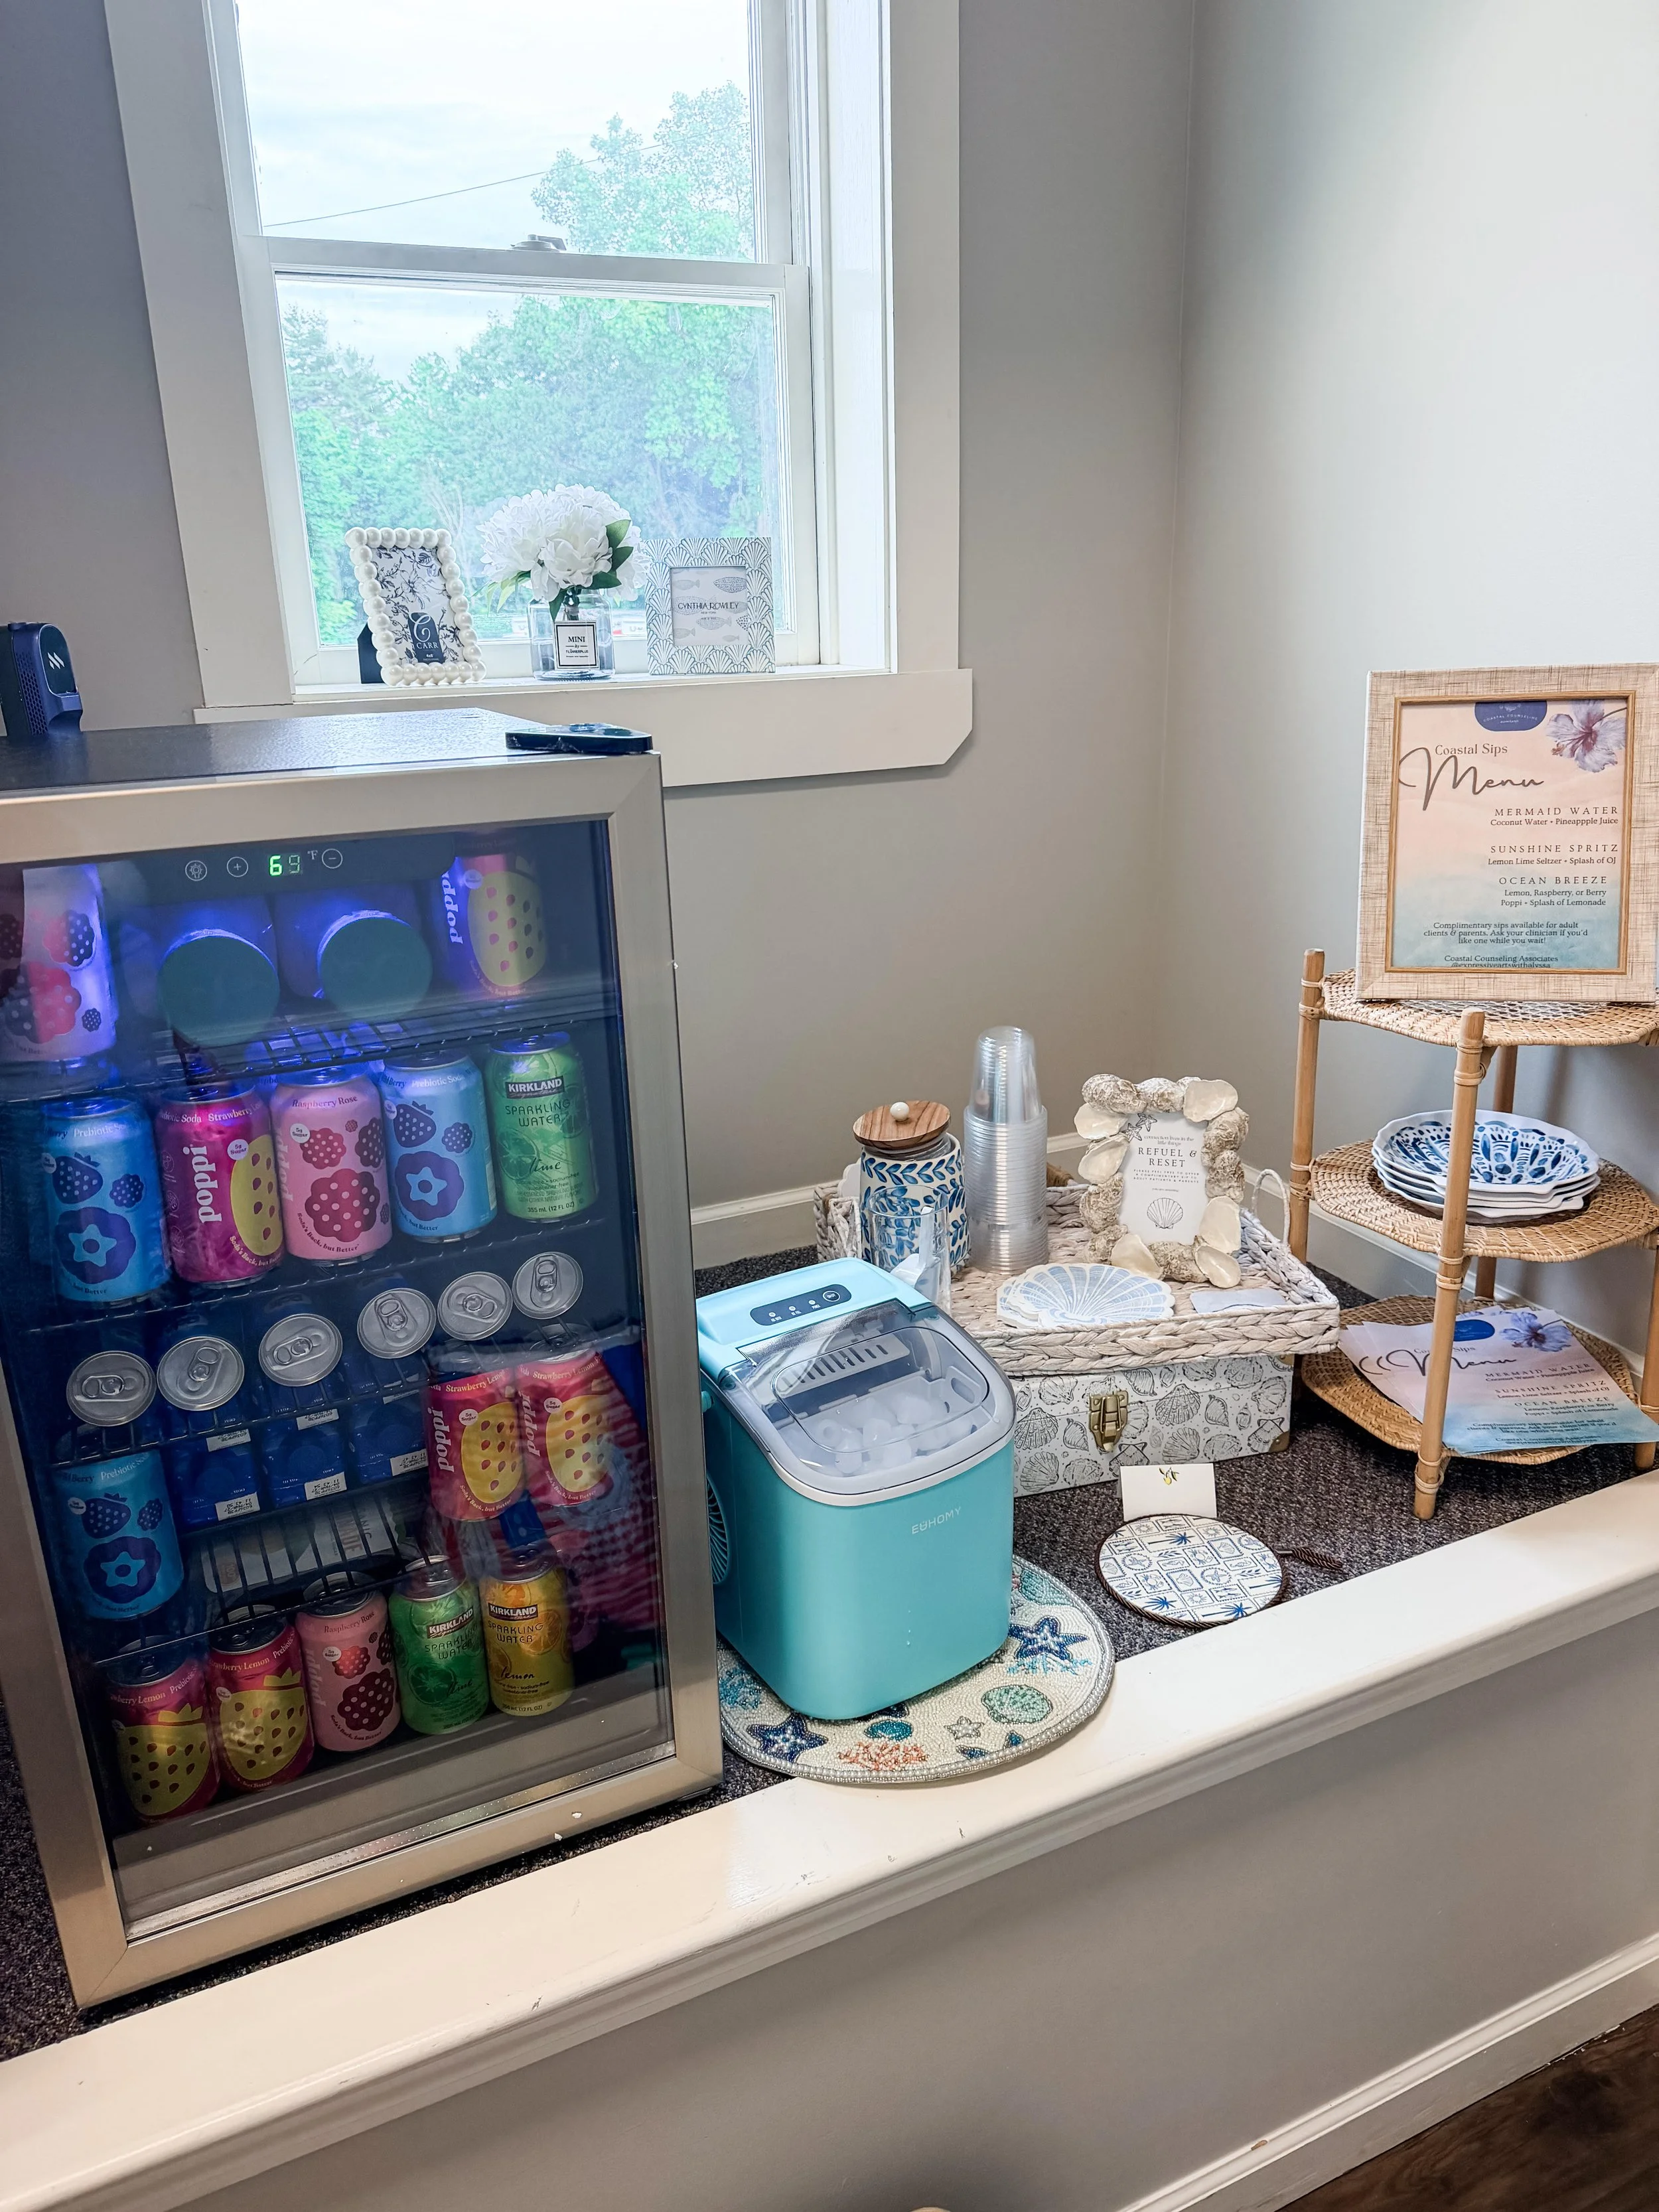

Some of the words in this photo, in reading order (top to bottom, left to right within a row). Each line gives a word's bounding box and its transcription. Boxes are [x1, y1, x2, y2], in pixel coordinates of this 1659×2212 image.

[1435, 744, 1477, 755] Coastal
[1482, 743, 1508, 757] Sips
[1398, 747, 1544, 811] Menu
[1494, 807, 1561, 816] MERMAID
[1570, 806, 1618, 815] WATER
[1555, 818, 1598, 826] Pineappple
[1490, 845, 1561, 853] SUNSHINE
[1569, 857, 1595, 865] Splash
[1567, 929, 1588, 938] you'd
[411, 1077, 447, 1088] Prebiotic
[508, 1078, 563, 1092] KIRKLAND
[292, 1099, 337, 1109] Raspberry
[338, 1095, 358, 1106] Rose
[505, 1099, 571, 1115] SPARKLING
[181, 1114, 202, 1123] Soda
[208, 1108, 252, 1122] Strawberry
[518, 1114, 561, 1127] WATER
[74, 1126, 113, 1138] Prebiotic
[1138, 1147, 1183, 1157] REFUEL
[1149, 1158, 1185, 1167] RESET
[182, 1143, 222, 1224] poppi
[323, 1243, 335, 1252] but
[336, 1244, 358, 1253] Better
[1548, 1363, 1591, 1372] WATER
[533, 1370, 572, 1380] Strawberry
[445, 1380, 487, 1392] Strawberry
[1563, 1380, 1607, 1389] SPRITZ
[518, 1391, 541, 1457] poppi
[427, 1406, 455, 1473] poppi
[100, 1462, 137, 1481] Prebiotic
[490, 1604, 537, 1616] KIRKLAND
[324, 1619, 361, 1634] Raspberry
[360, 1611, 375, 1622] Rose
[429, 1608, 474, 1634] KIRKLAND
[488, 1620, 543, 1635] SPARKLING
[425, 1623, 478, 1653] SPARKLING
[497, 1635, 533, 1644] WATER
[439, 1639, 473, 1660] WATER
[244, 1657, 270, 1670] Lemon
[500, 1666, 535, 1679] lemon
[138, 1693, 166, 1705] Lemon
